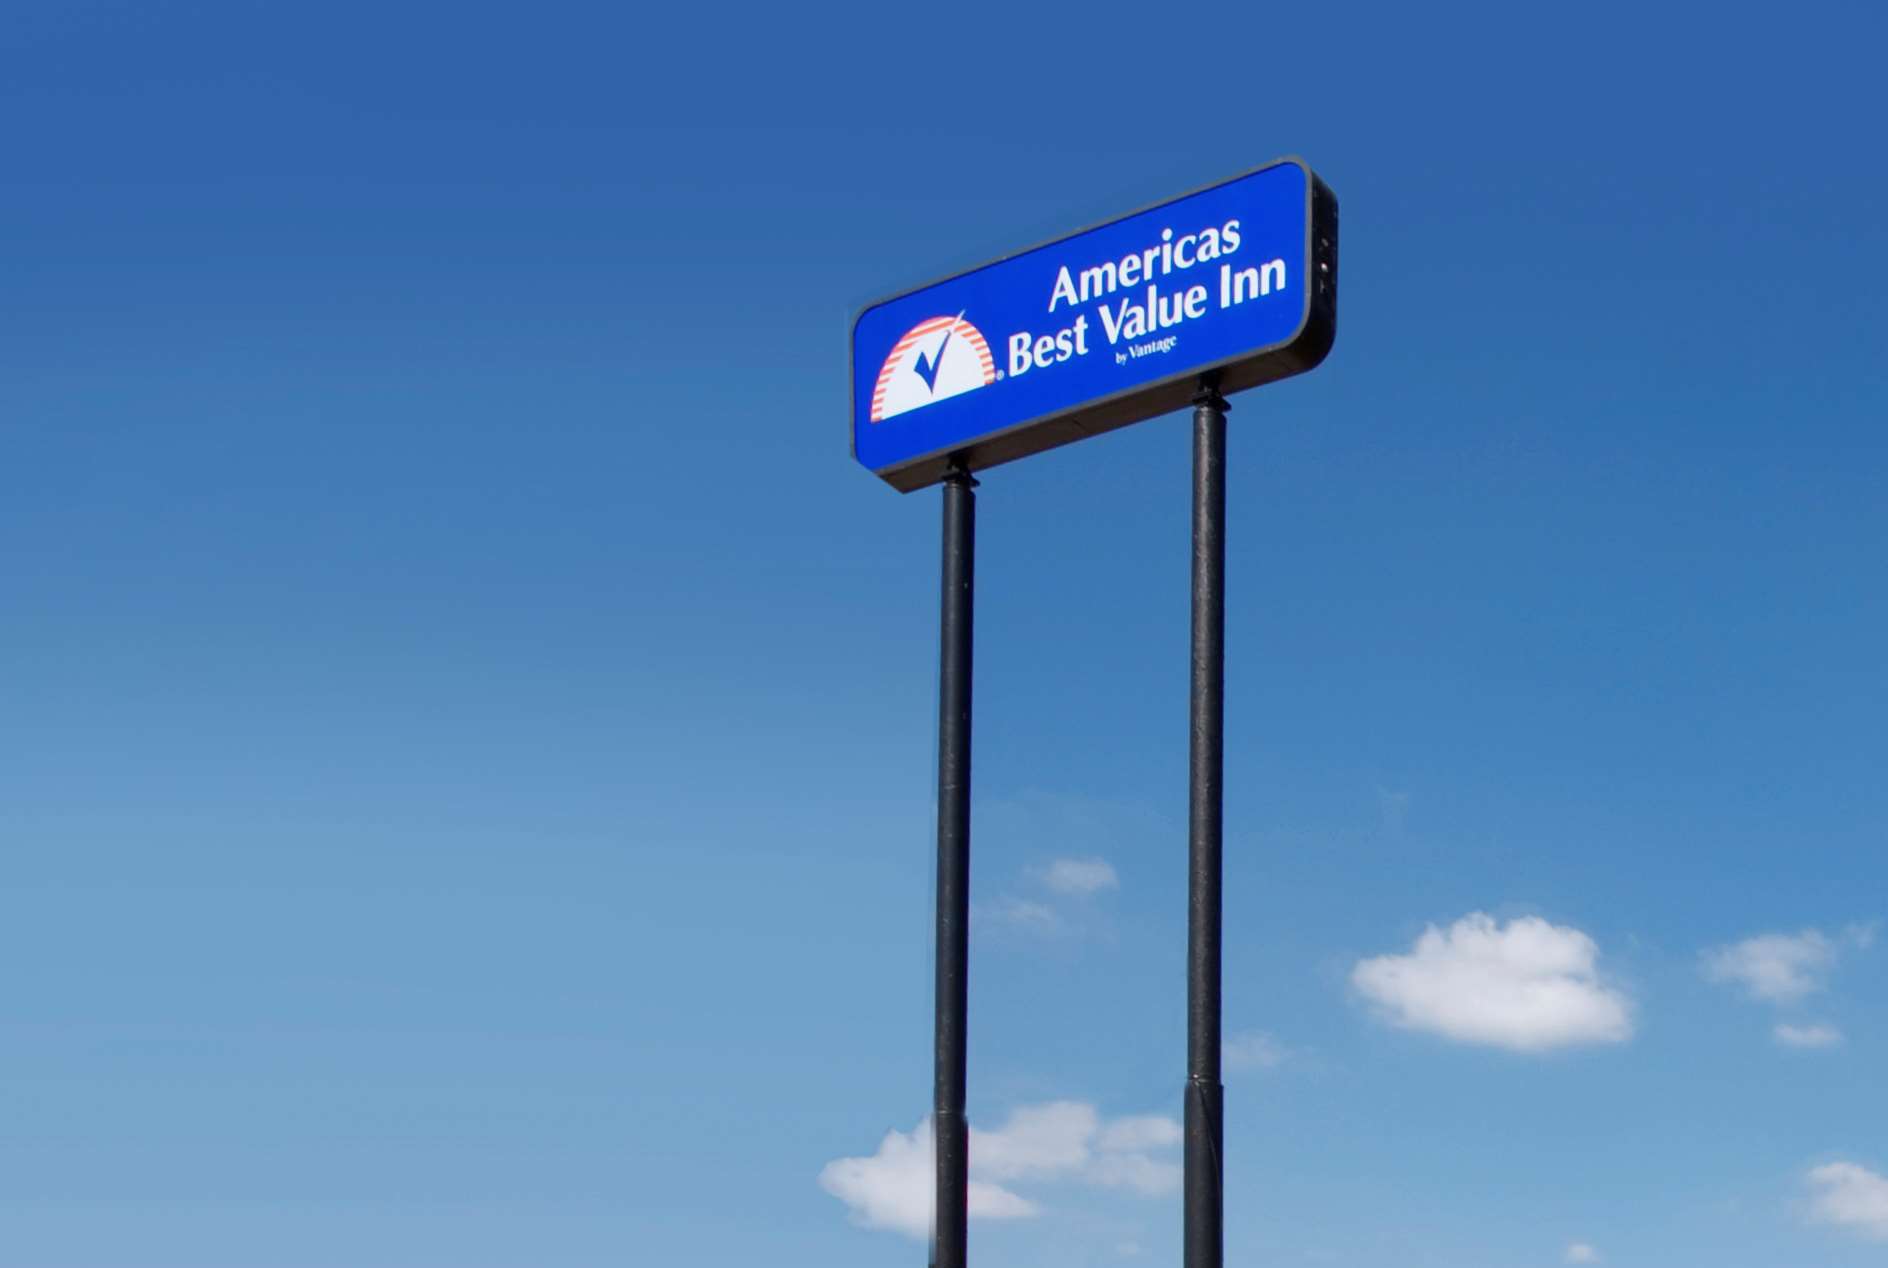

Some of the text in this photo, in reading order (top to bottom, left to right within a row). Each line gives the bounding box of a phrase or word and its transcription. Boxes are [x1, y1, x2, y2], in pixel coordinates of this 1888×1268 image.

[1048, 219, 1241, 313] Americas
[1008, 258, 1286, 377] Best Value Inn
[1115, 335, 1177, 367] by Vantage
